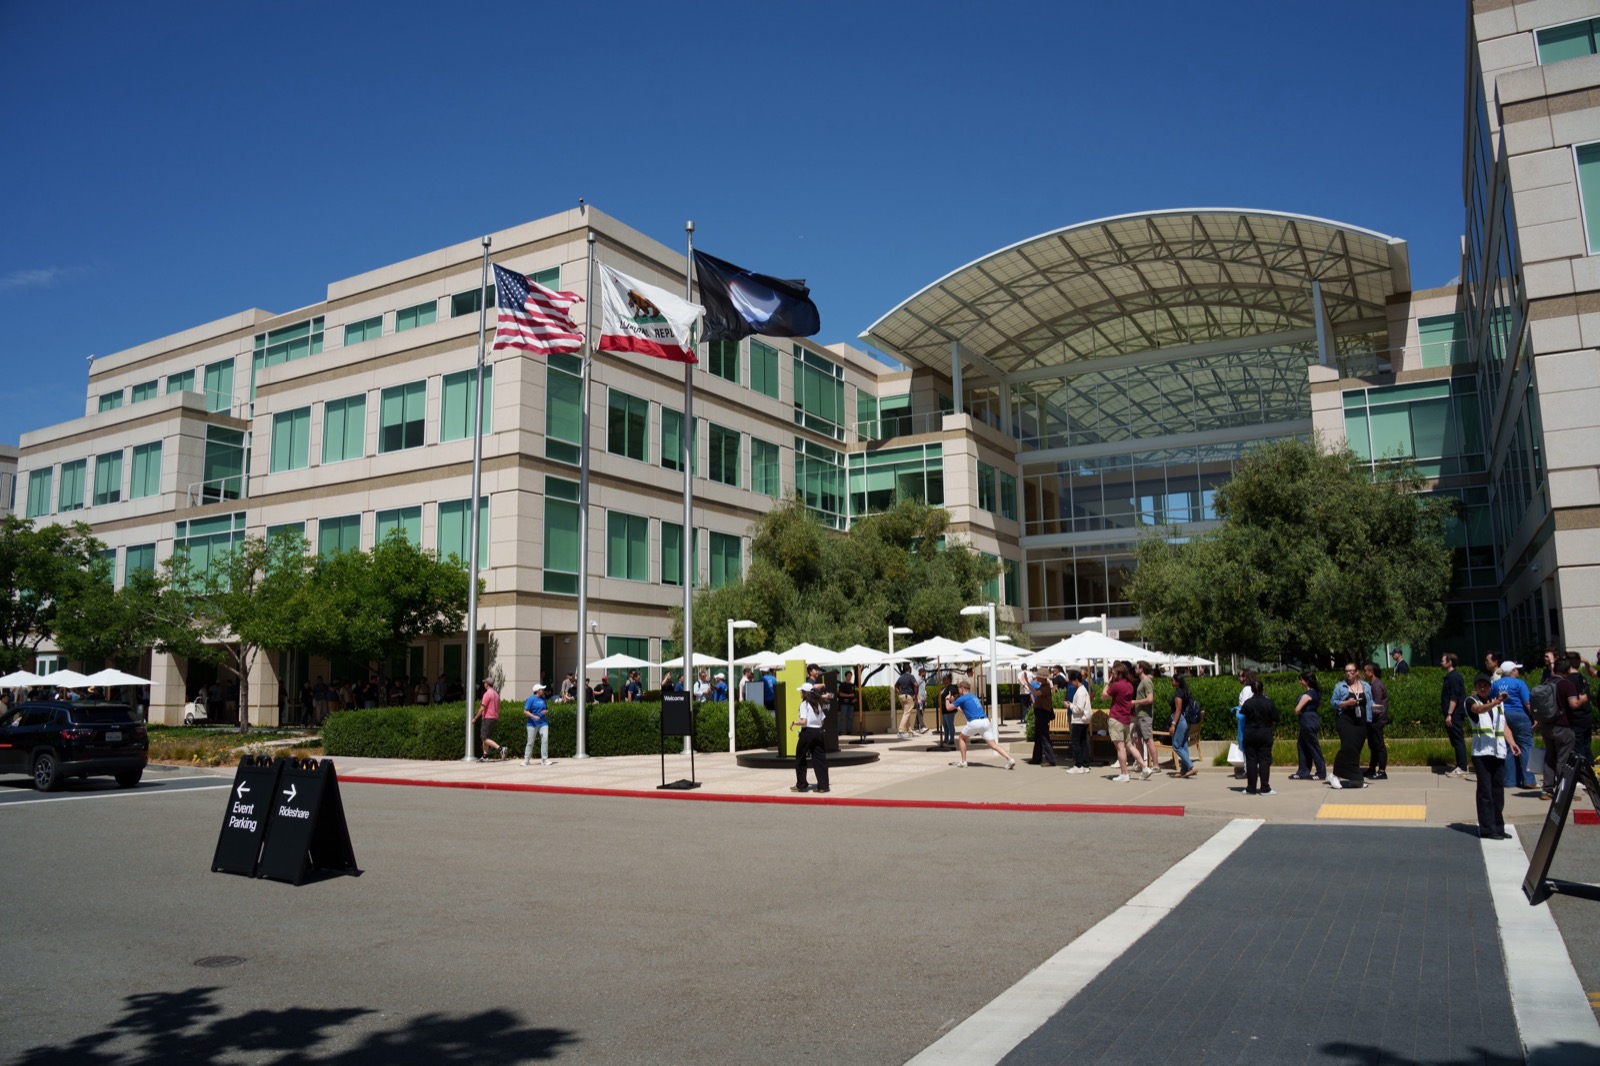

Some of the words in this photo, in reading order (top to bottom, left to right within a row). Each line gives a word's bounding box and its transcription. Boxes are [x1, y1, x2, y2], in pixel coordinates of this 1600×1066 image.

[232, 801, 254, 815] Event
[278, 805, 310, 819] Rideshare
[228, 815, 258, 832] Parking
